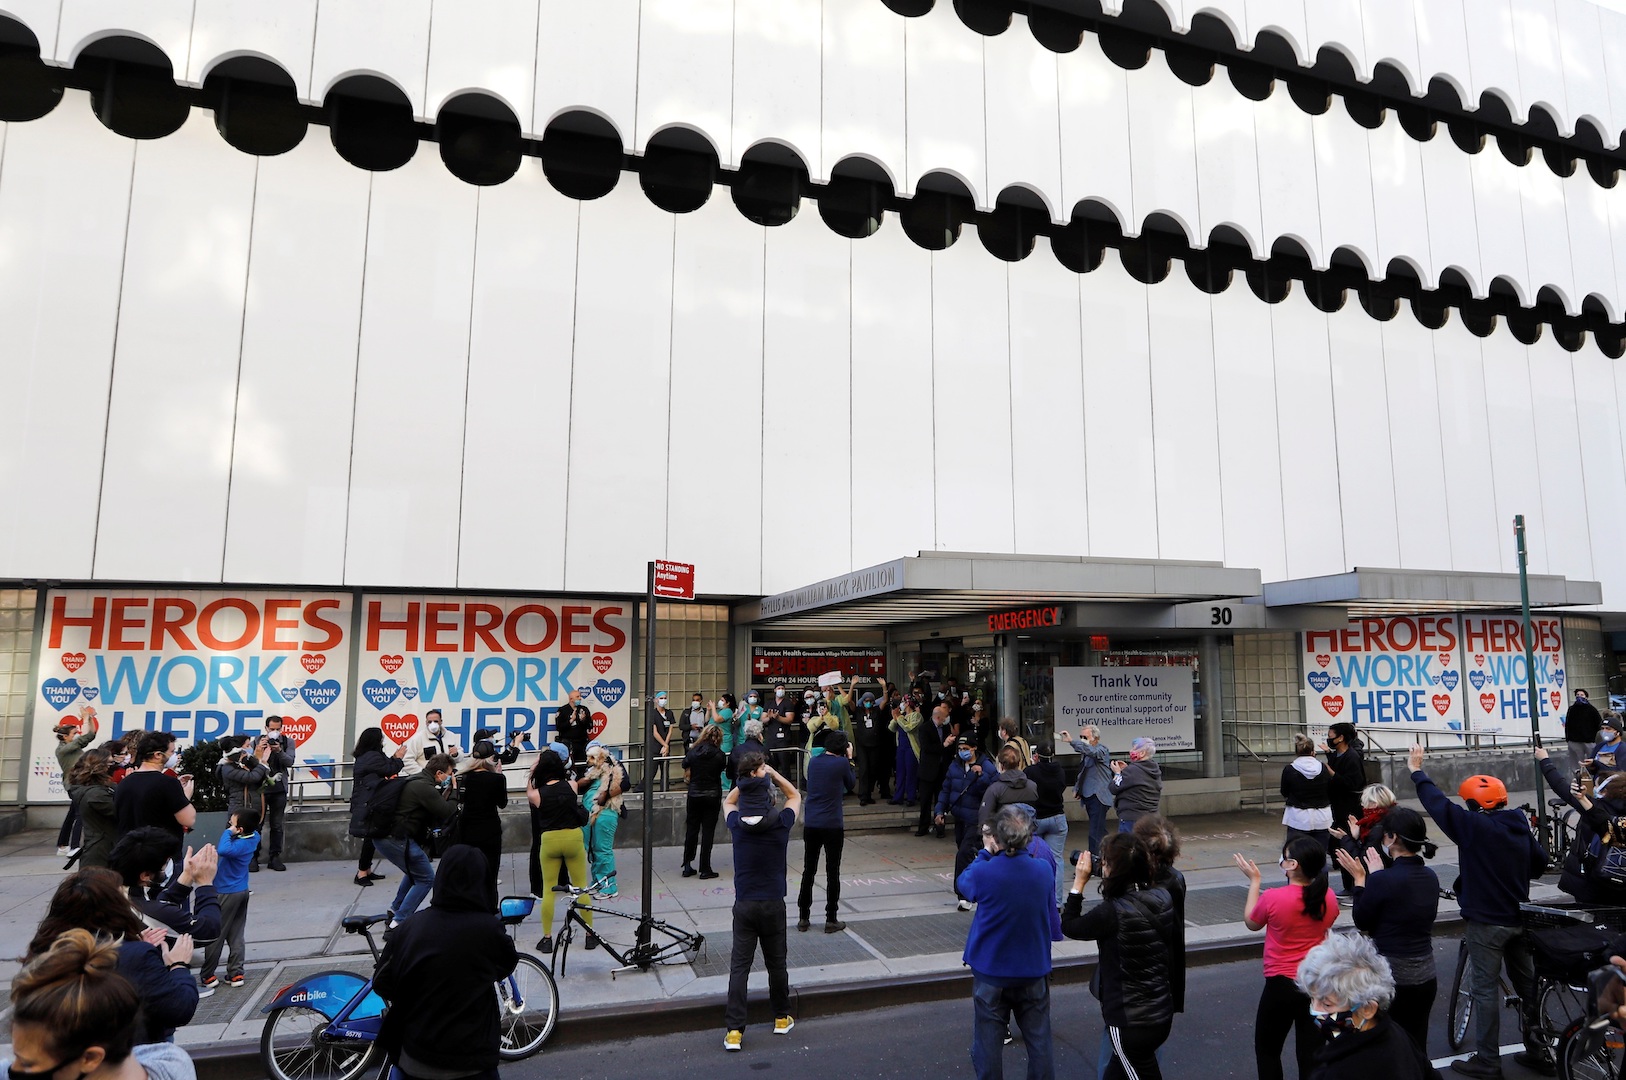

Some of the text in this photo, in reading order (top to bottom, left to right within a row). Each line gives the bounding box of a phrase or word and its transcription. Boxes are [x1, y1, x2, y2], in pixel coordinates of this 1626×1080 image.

[657, 572, 678, 580] Anytime
[665, 564, 689, 574] STANDING
[760, 567, 895, 615] PHYLLIS AND WILLIAM MACK PAVILION
[48, 596, 344, 651] HEROES
[366, 602, 626, 653] HEROES
[988, 607, 1058, 632] EMERGENCY
[1211, 607, 1232, 625] 30
[1465, 619, 1561, 652] HEROES
[95, 655, 288, 705] WORK
[412, 657, 582, 703] WORK
[1092, 674, 1158, 687] Thank You
[1335, 655, 1433, 687] WORK
[1488, 655, 1552, 685] WORK
[1076, 707, 1094, 716] your
[1096, 705, 1132, 714] continual
[1134, 705, 1163, 715] support
[1165, 704, 1173, 712] of
[1130, 692, 1172, 702] community
[1351, 690, 1427, 723] HERE
[1077, 716, 1174, 726] LHGV Healthcare Heroes!
